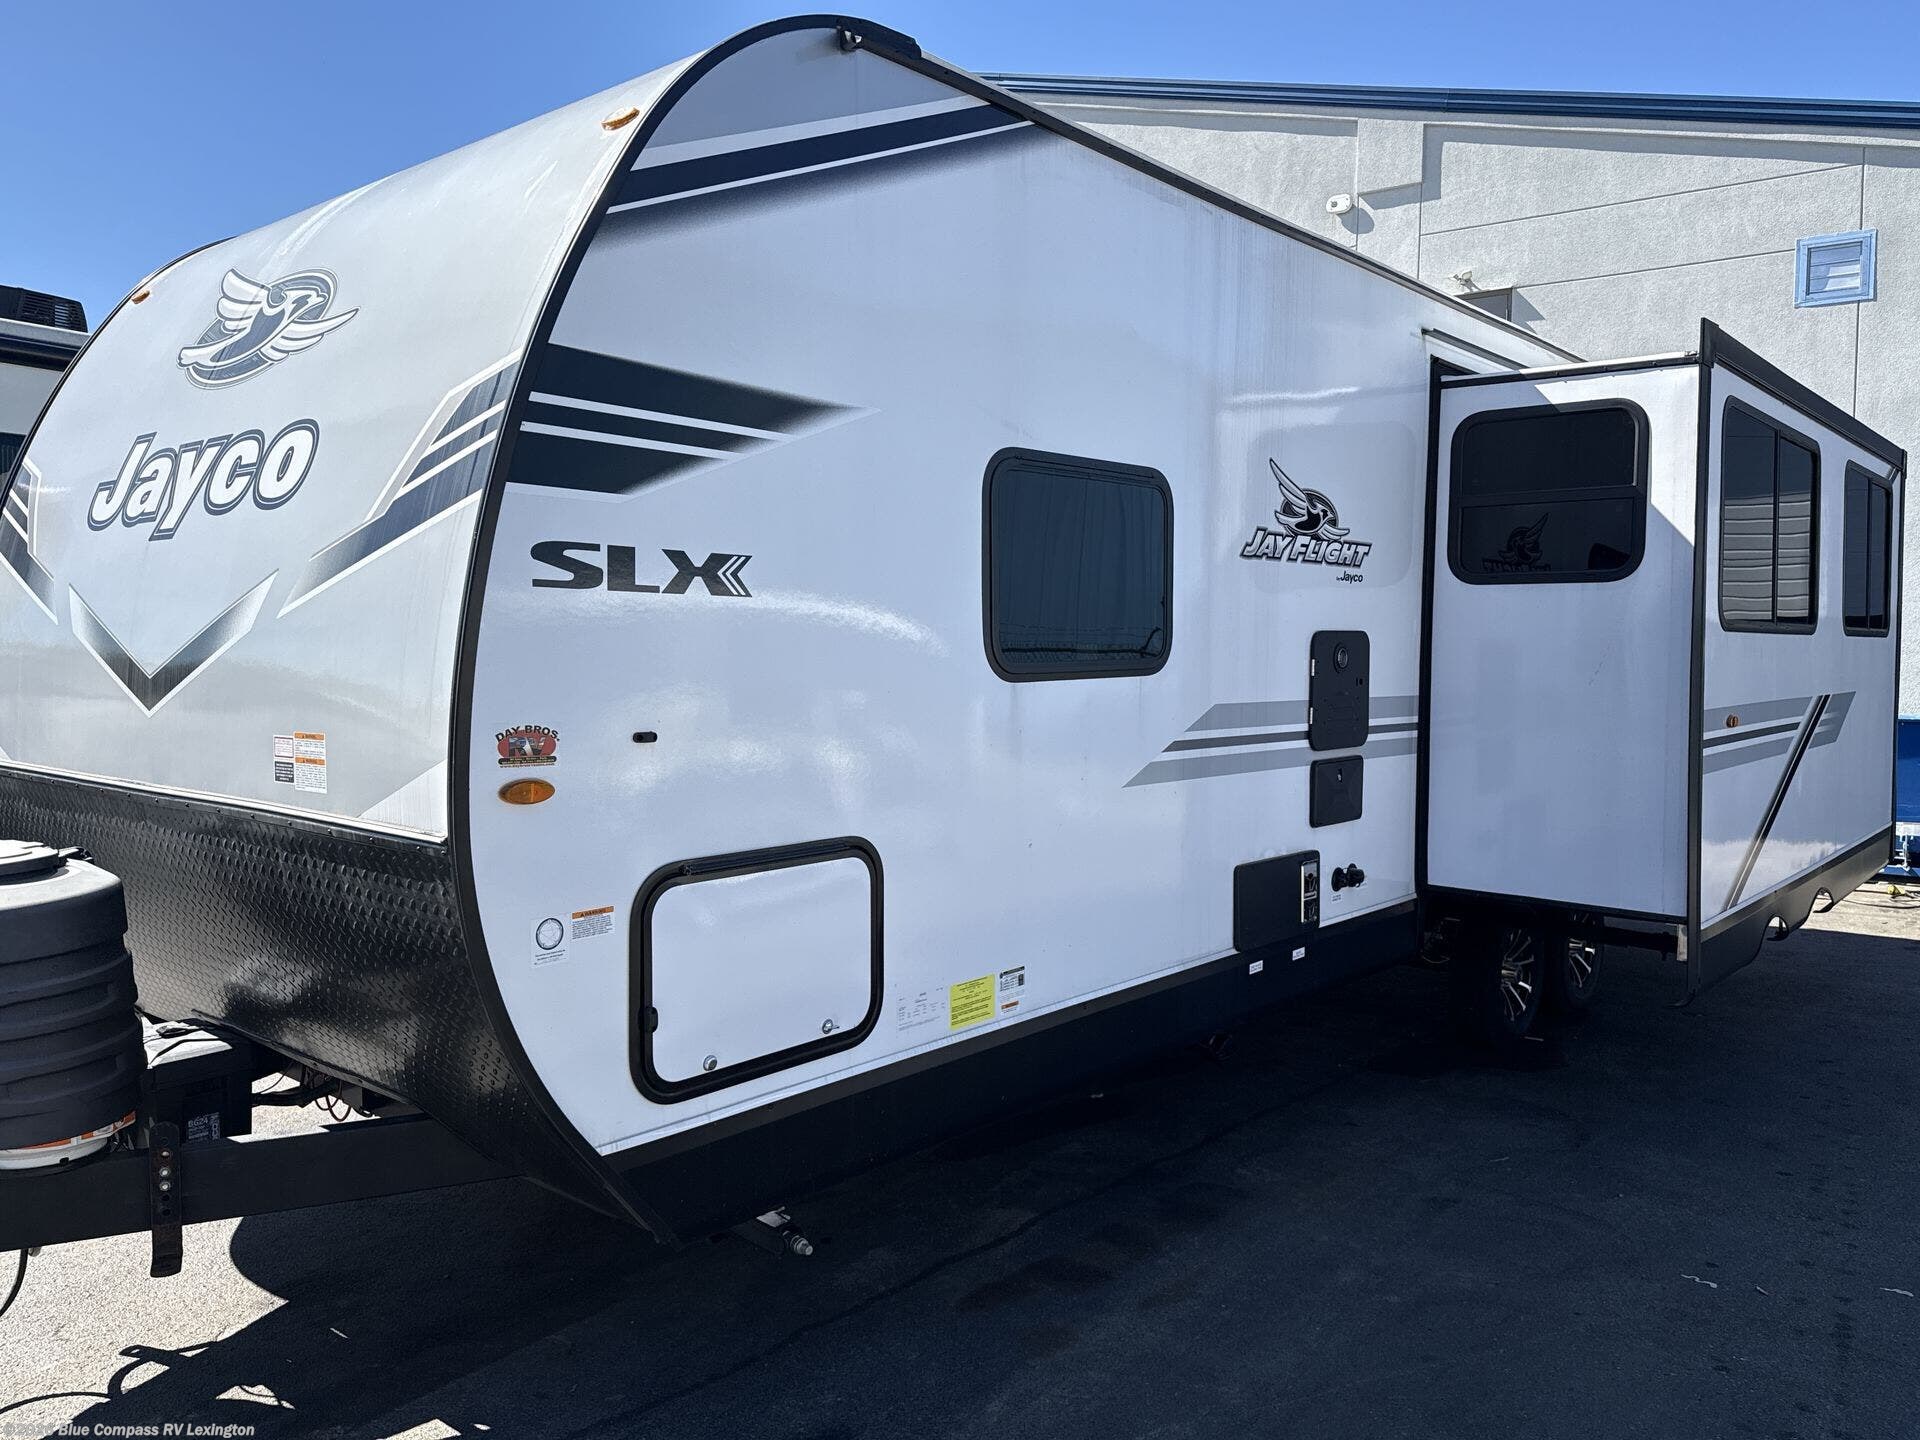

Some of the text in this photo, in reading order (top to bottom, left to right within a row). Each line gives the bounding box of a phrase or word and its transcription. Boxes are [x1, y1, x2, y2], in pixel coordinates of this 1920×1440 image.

[87, 418, 320, 541] Jayco
[530, 540, 753, 598] SLX
[1341, 570, 1364, 584] Jayco
[495, 725, 560, 742] DAY BROS.
[508, 736, 546, 757] RV
